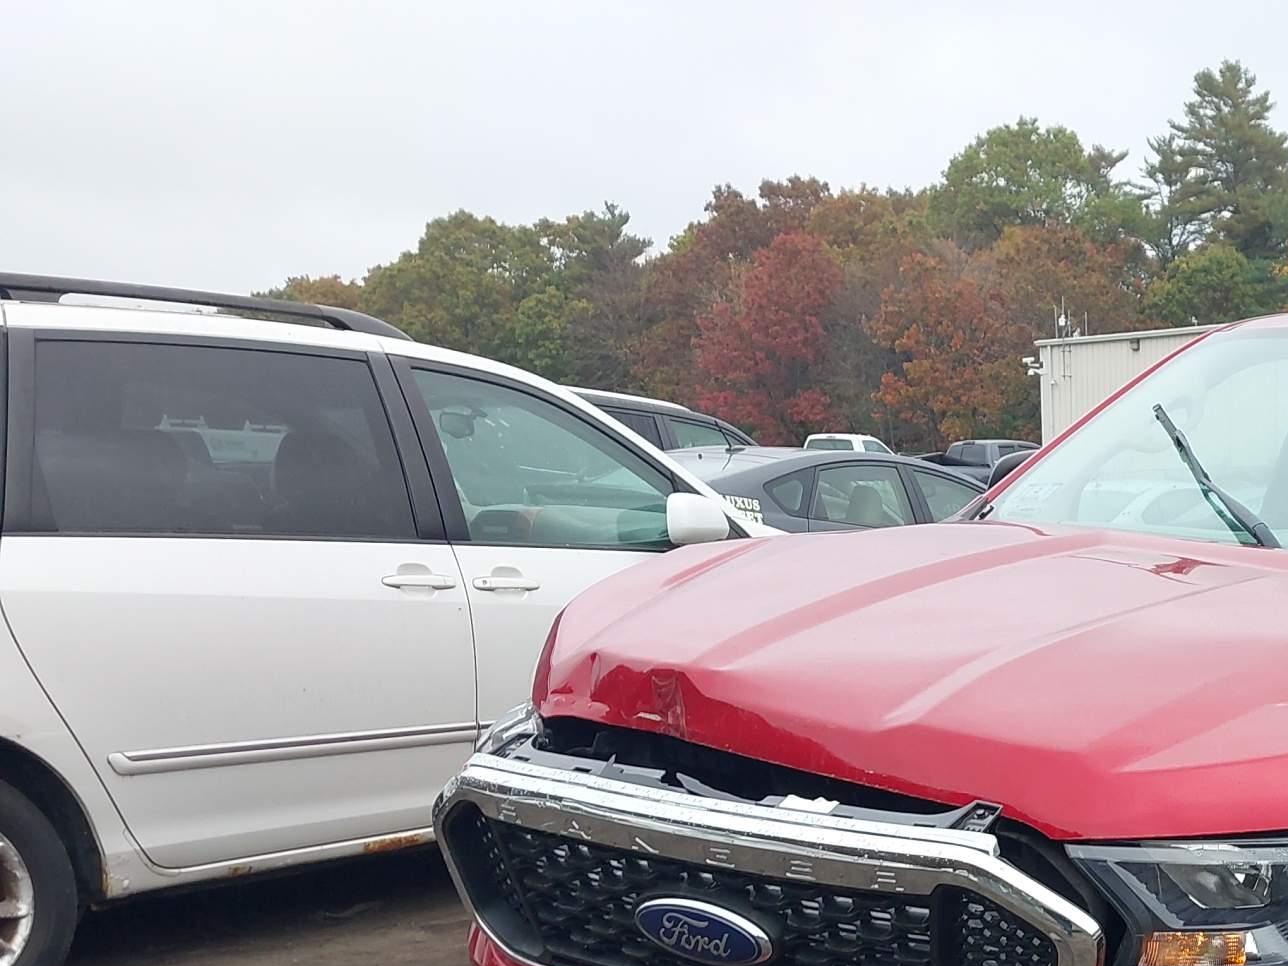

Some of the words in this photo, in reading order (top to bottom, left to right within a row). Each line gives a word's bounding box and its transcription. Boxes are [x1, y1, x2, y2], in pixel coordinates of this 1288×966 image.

[720, 494, 761, 511] UXUS
[497, 799, 907, 893] RANGER
[659, 911, 732, 958] Ford
